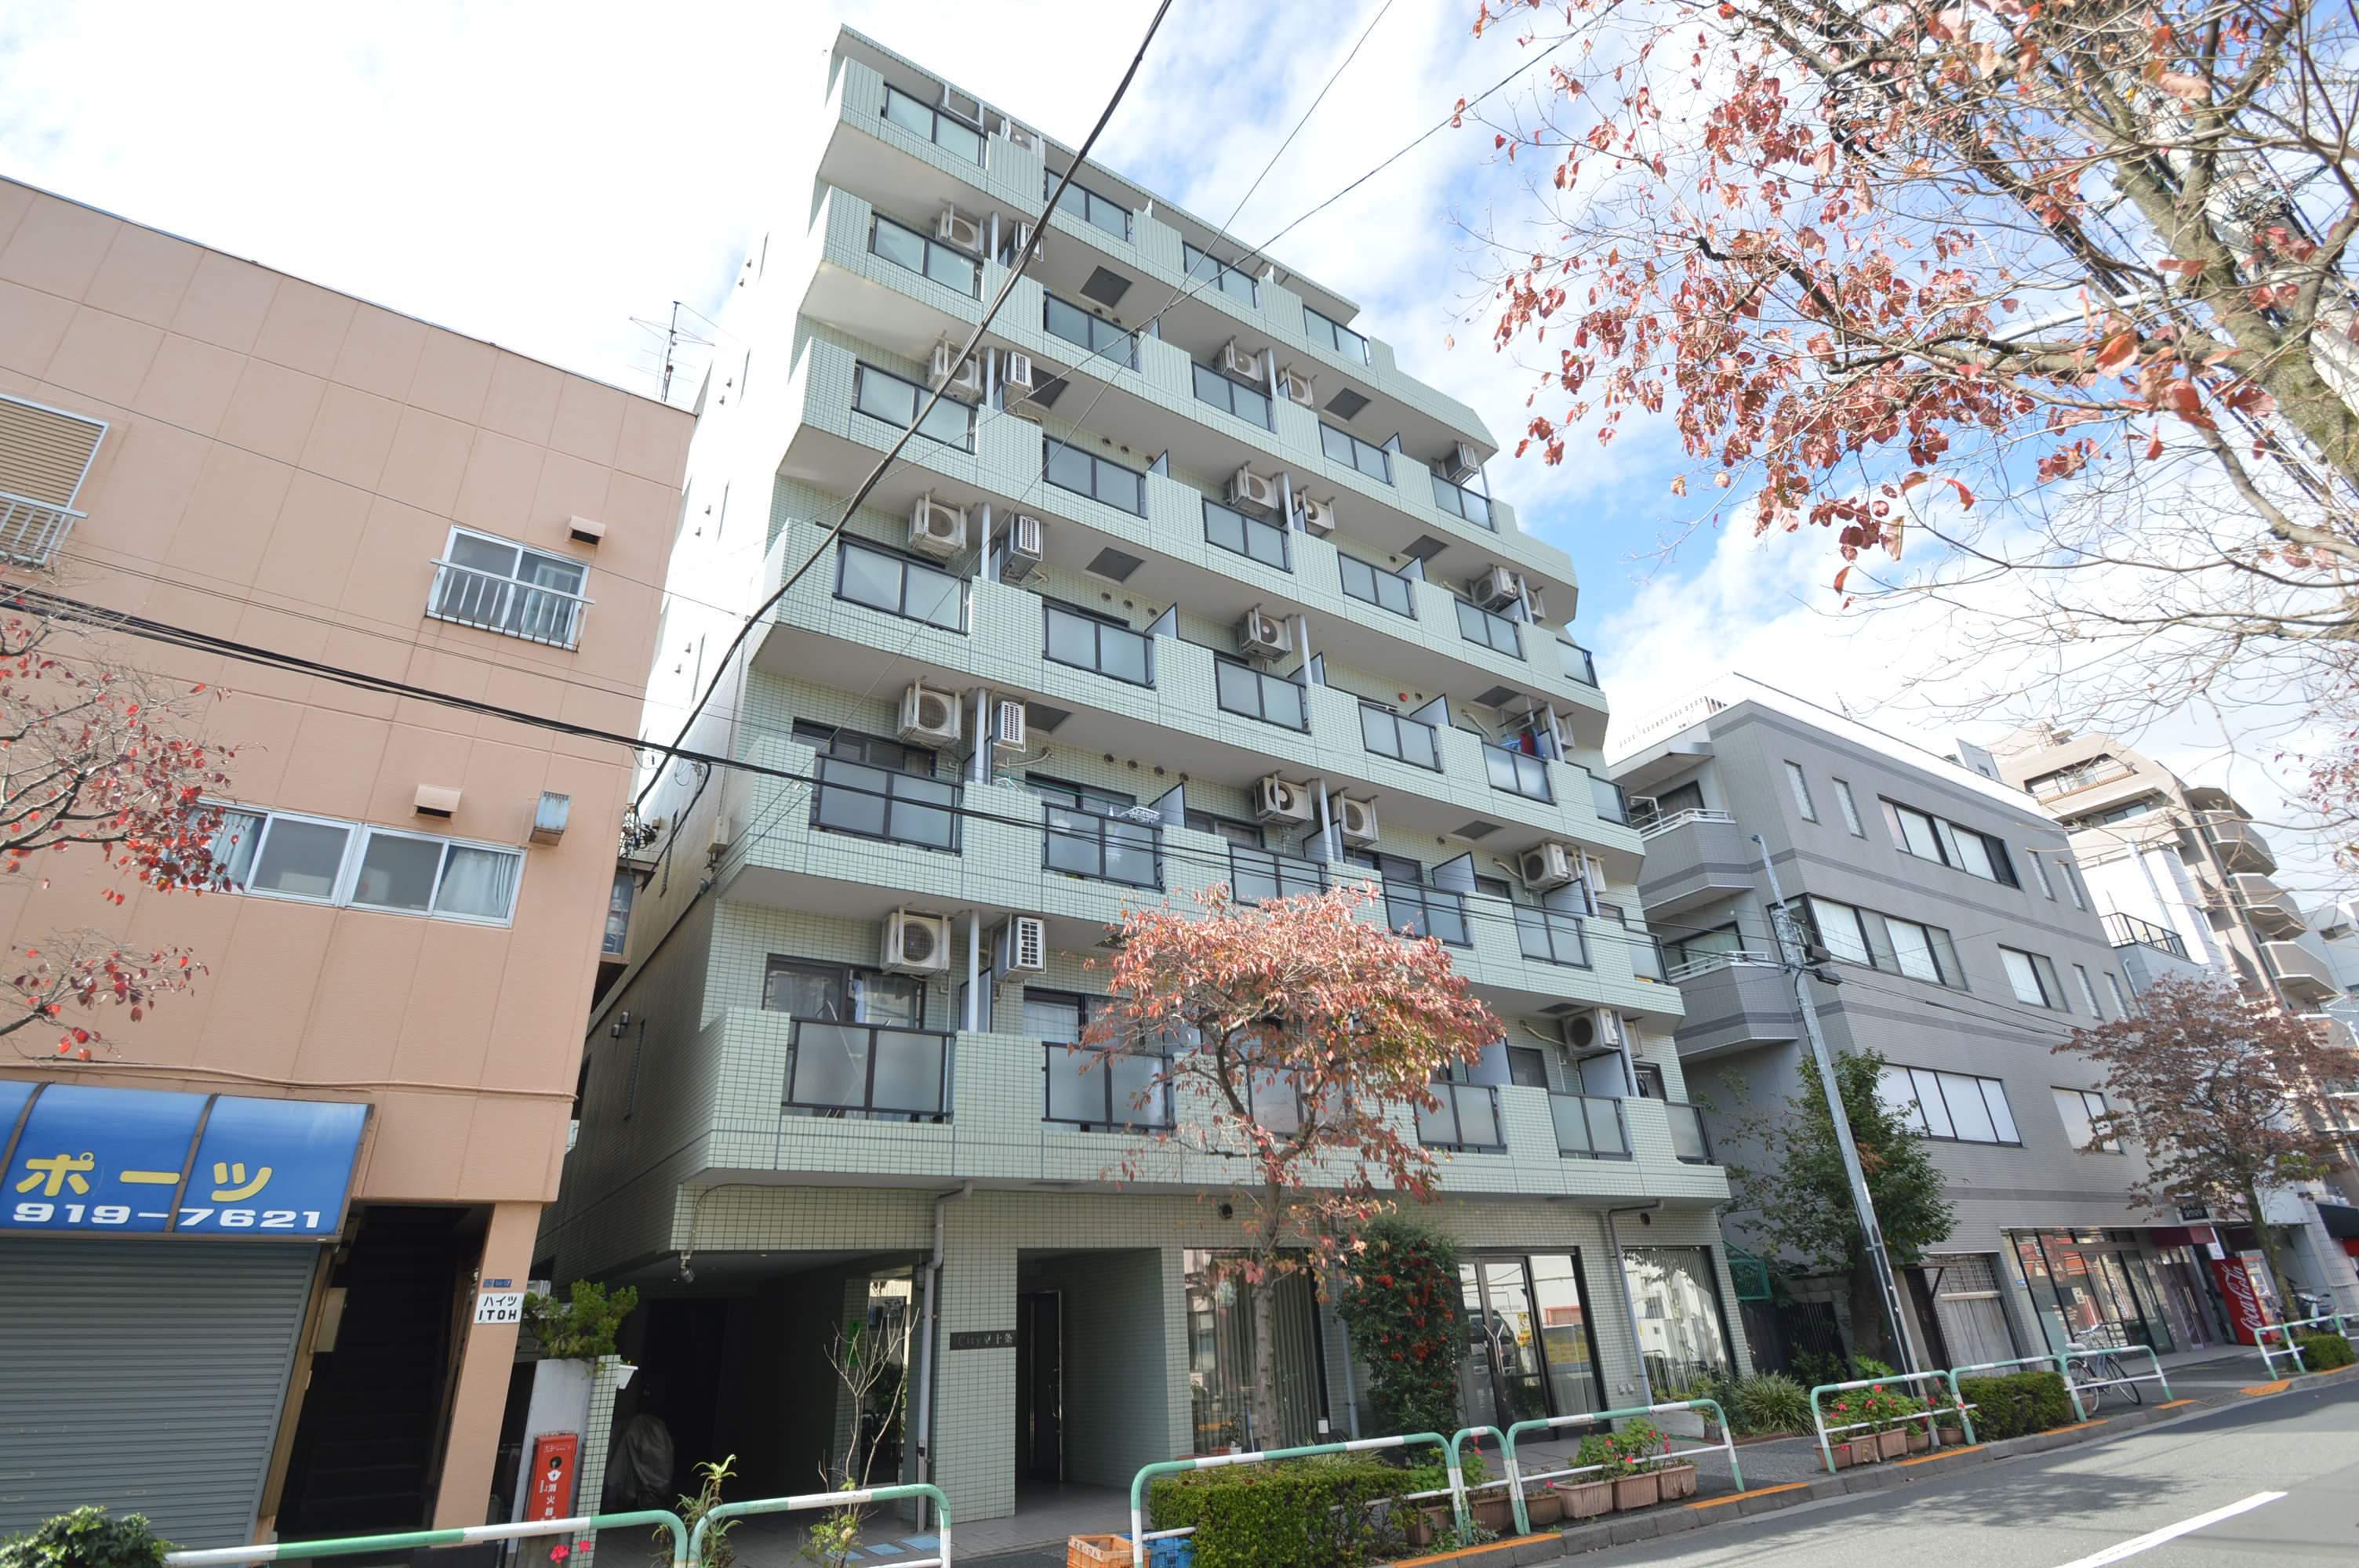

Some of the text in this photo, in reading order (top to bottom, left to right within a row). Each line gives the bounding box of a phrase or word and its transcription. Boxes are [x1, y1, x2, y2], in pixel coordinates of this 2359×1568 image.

[16, 1152, 272, 1202] ポーツ
[13, 1202, 321, 1229] 919-7621
[483, 1295, 518, 1307] ハイツ
[478, 1309, 518, 1320] ITOH
